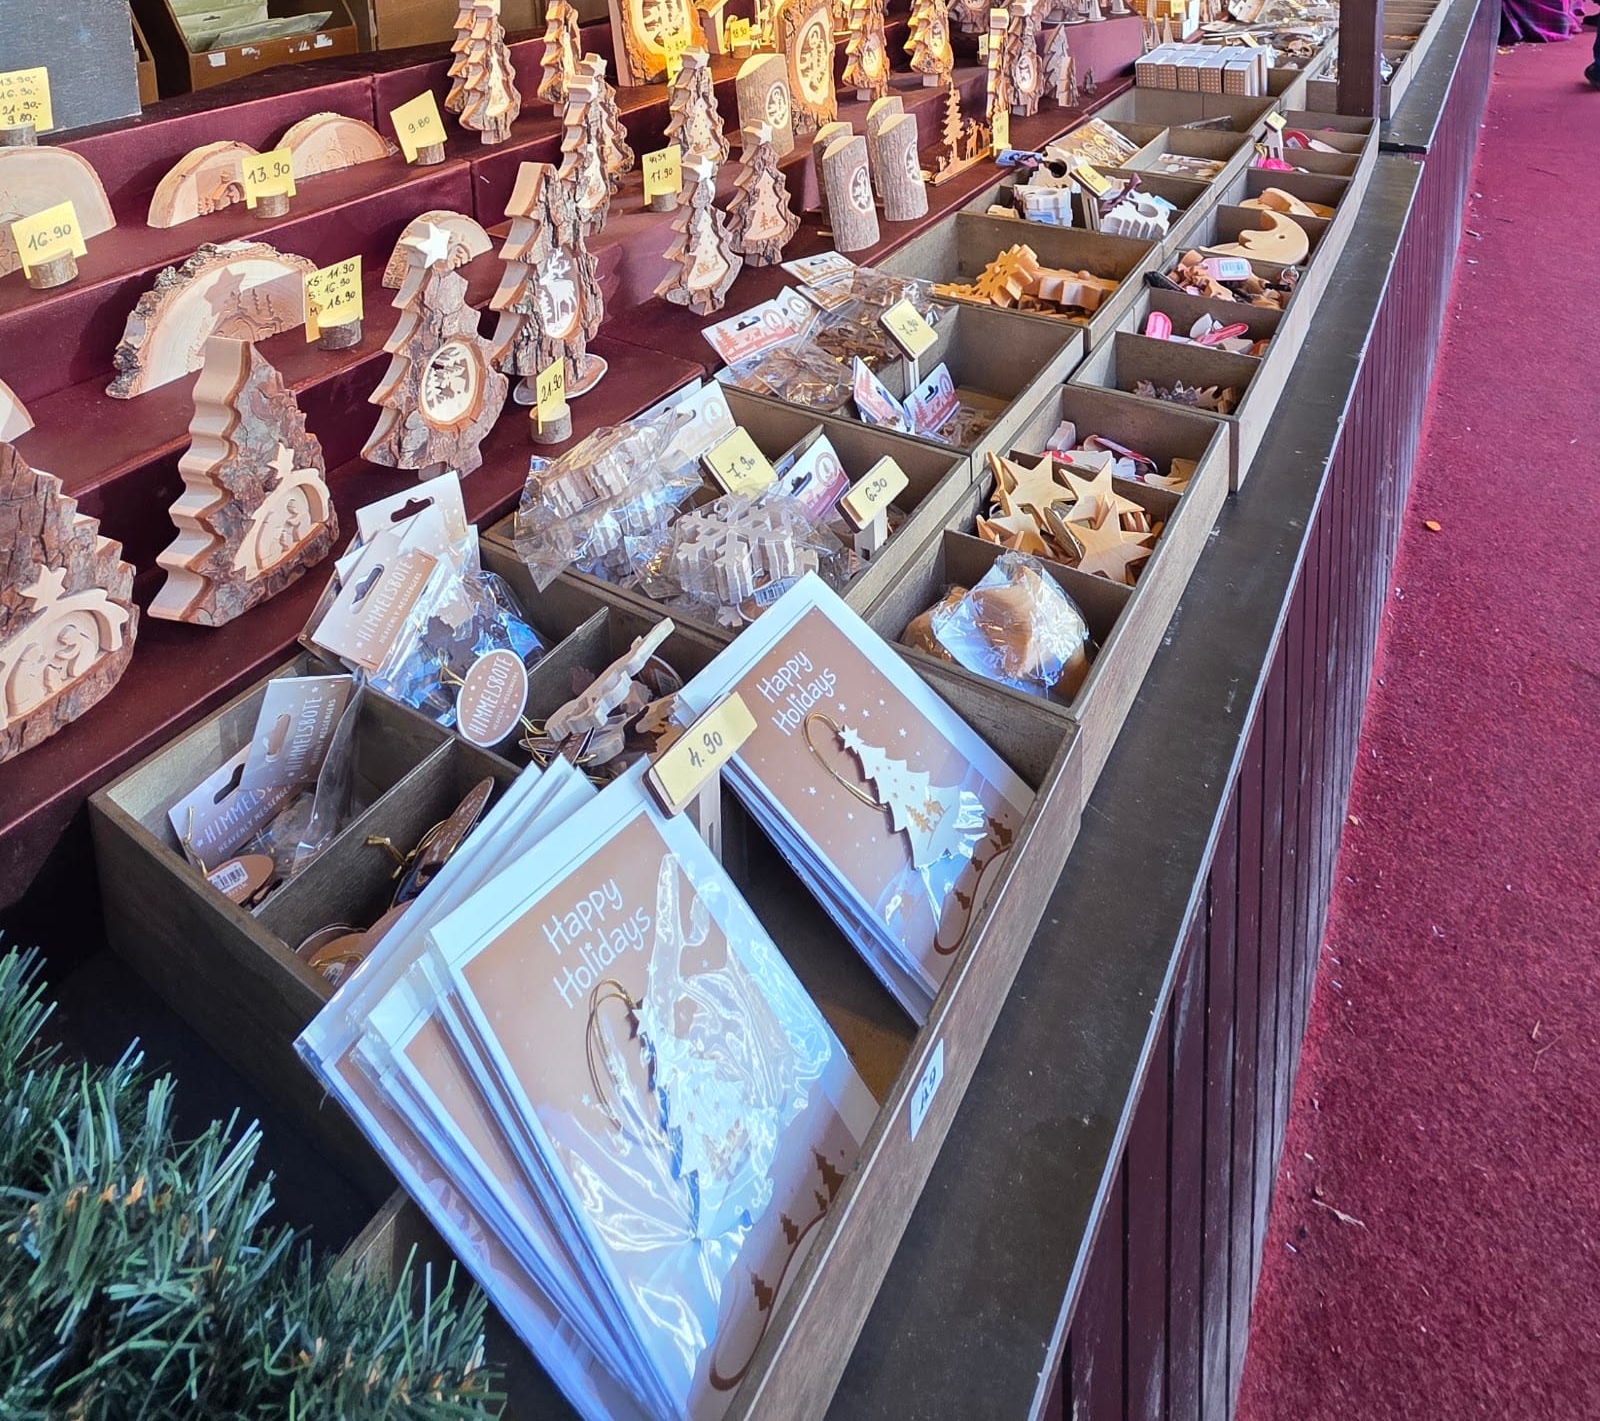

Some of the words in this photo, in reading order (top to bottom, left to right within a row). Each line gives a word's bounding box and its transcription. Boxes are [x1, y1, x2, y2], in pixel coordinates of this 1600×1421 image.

[248, 162, 290, 184] 13.90
[28, 224, 72, 251] 16.90
[865, 478, 888, 502] 6.90
[356, 560, 414, 642] HIMMELSBOTE
[467, 656, 513, 736] HIMMELSBOTE
[756, 651, 813, 703] Happy
[771, 668, 837, 736] Holidays
[285, 696, 323, 772] HIMMELSBOTE
[688, 731, 723, 768] 4.90
[542, 878, 623, 955] Happy
[553, 907, 651, 1010] Holidays
